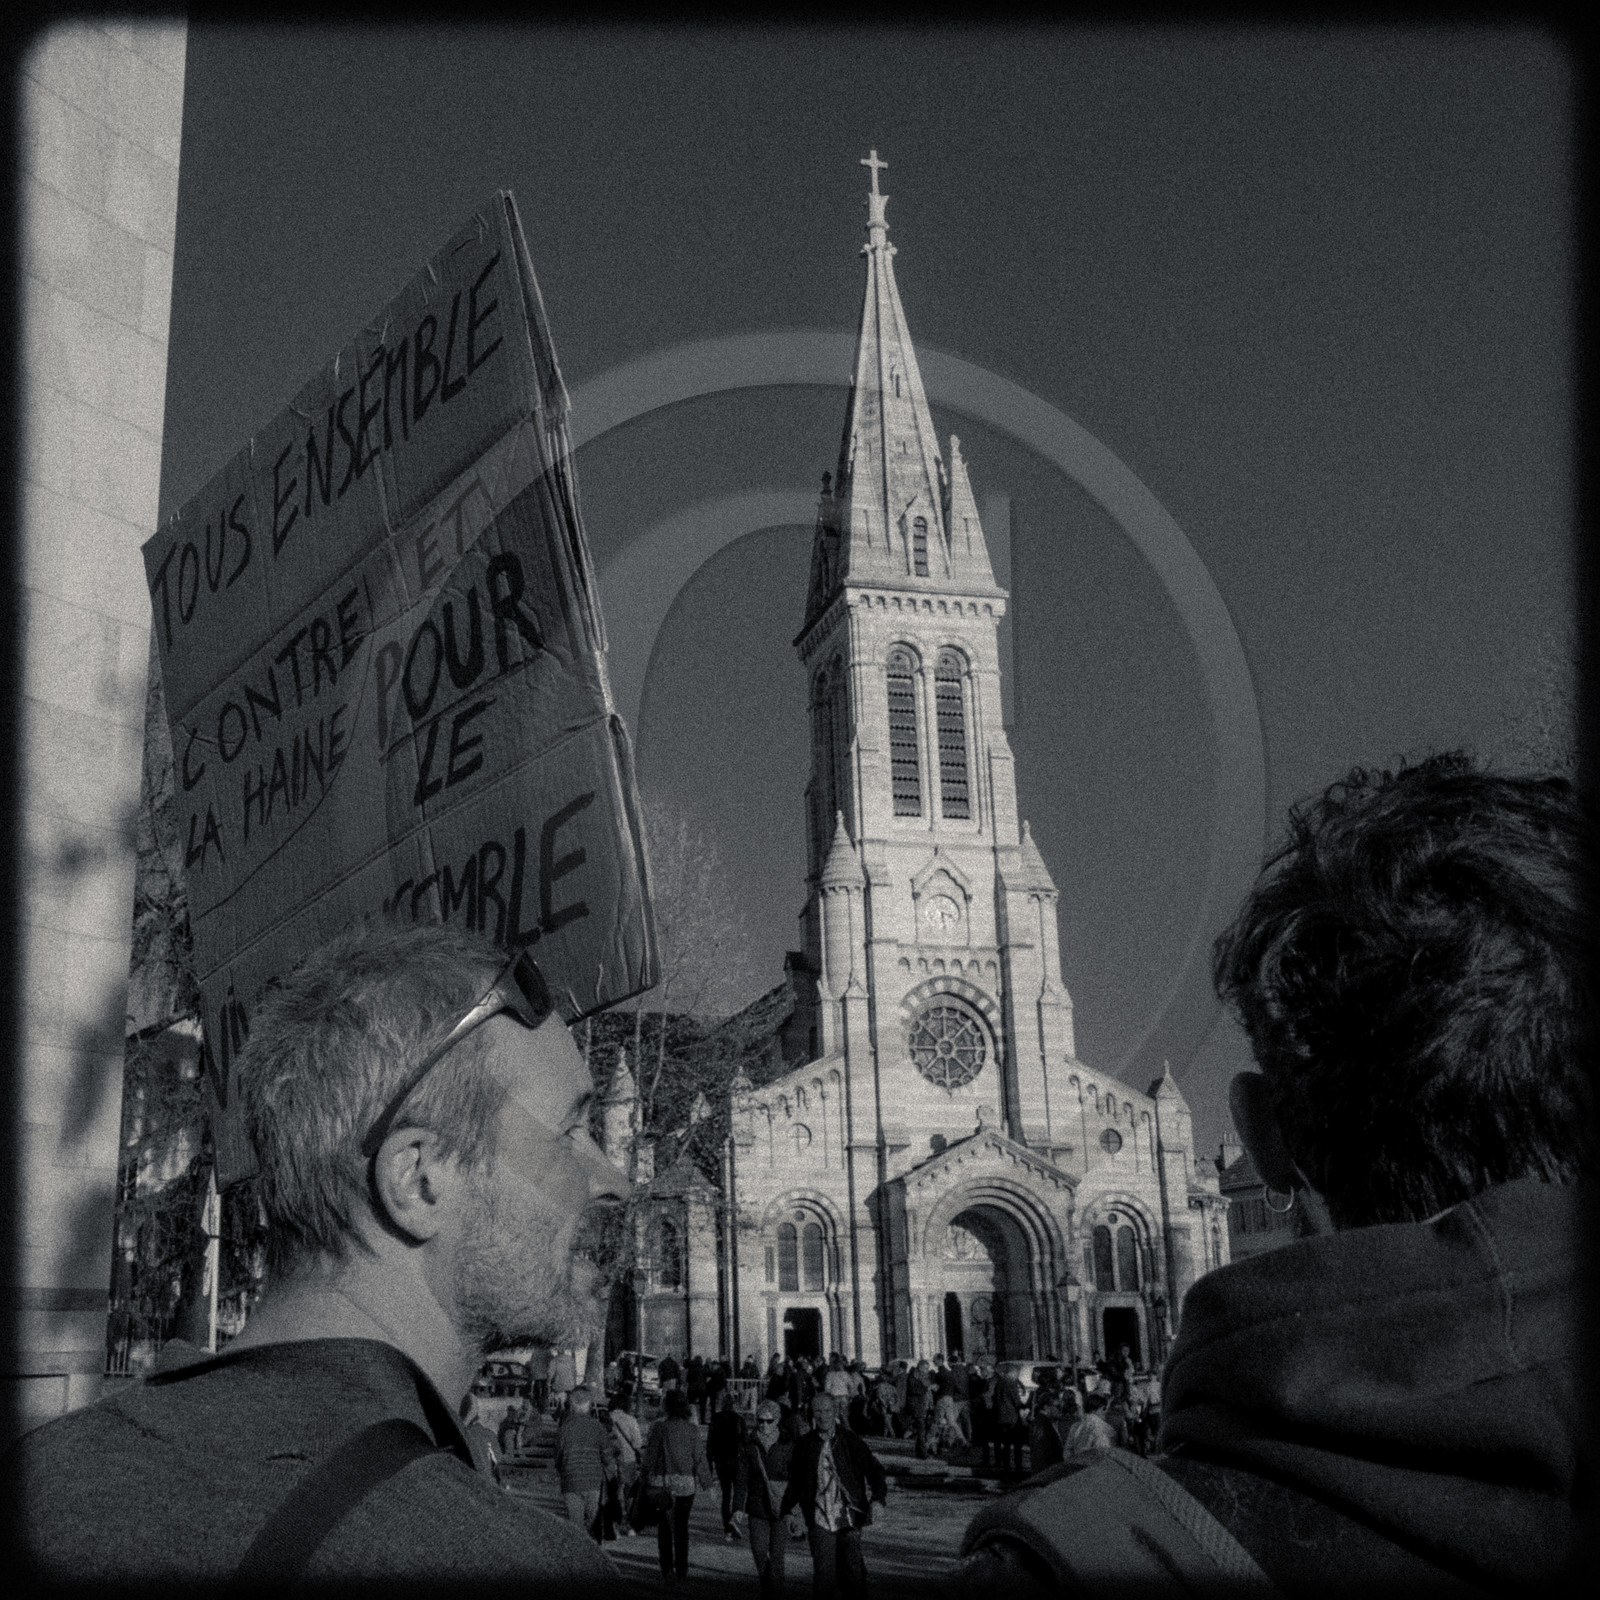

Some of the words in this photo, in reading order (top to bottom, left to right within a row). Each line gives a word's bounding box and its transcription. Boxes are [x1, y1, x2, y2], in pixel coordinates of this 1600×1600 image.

[151, 495, 253, 654] TOUS
[271, 248, 505, 562] ENSEMBLE
[416, 477, 482, 590] ET
[181, 587, 366, 792] CONTRE
[375, 550, 545, 750] POUR
[184, 803, 226, 870] LA
[242, 702, 349, 845] HAINE
